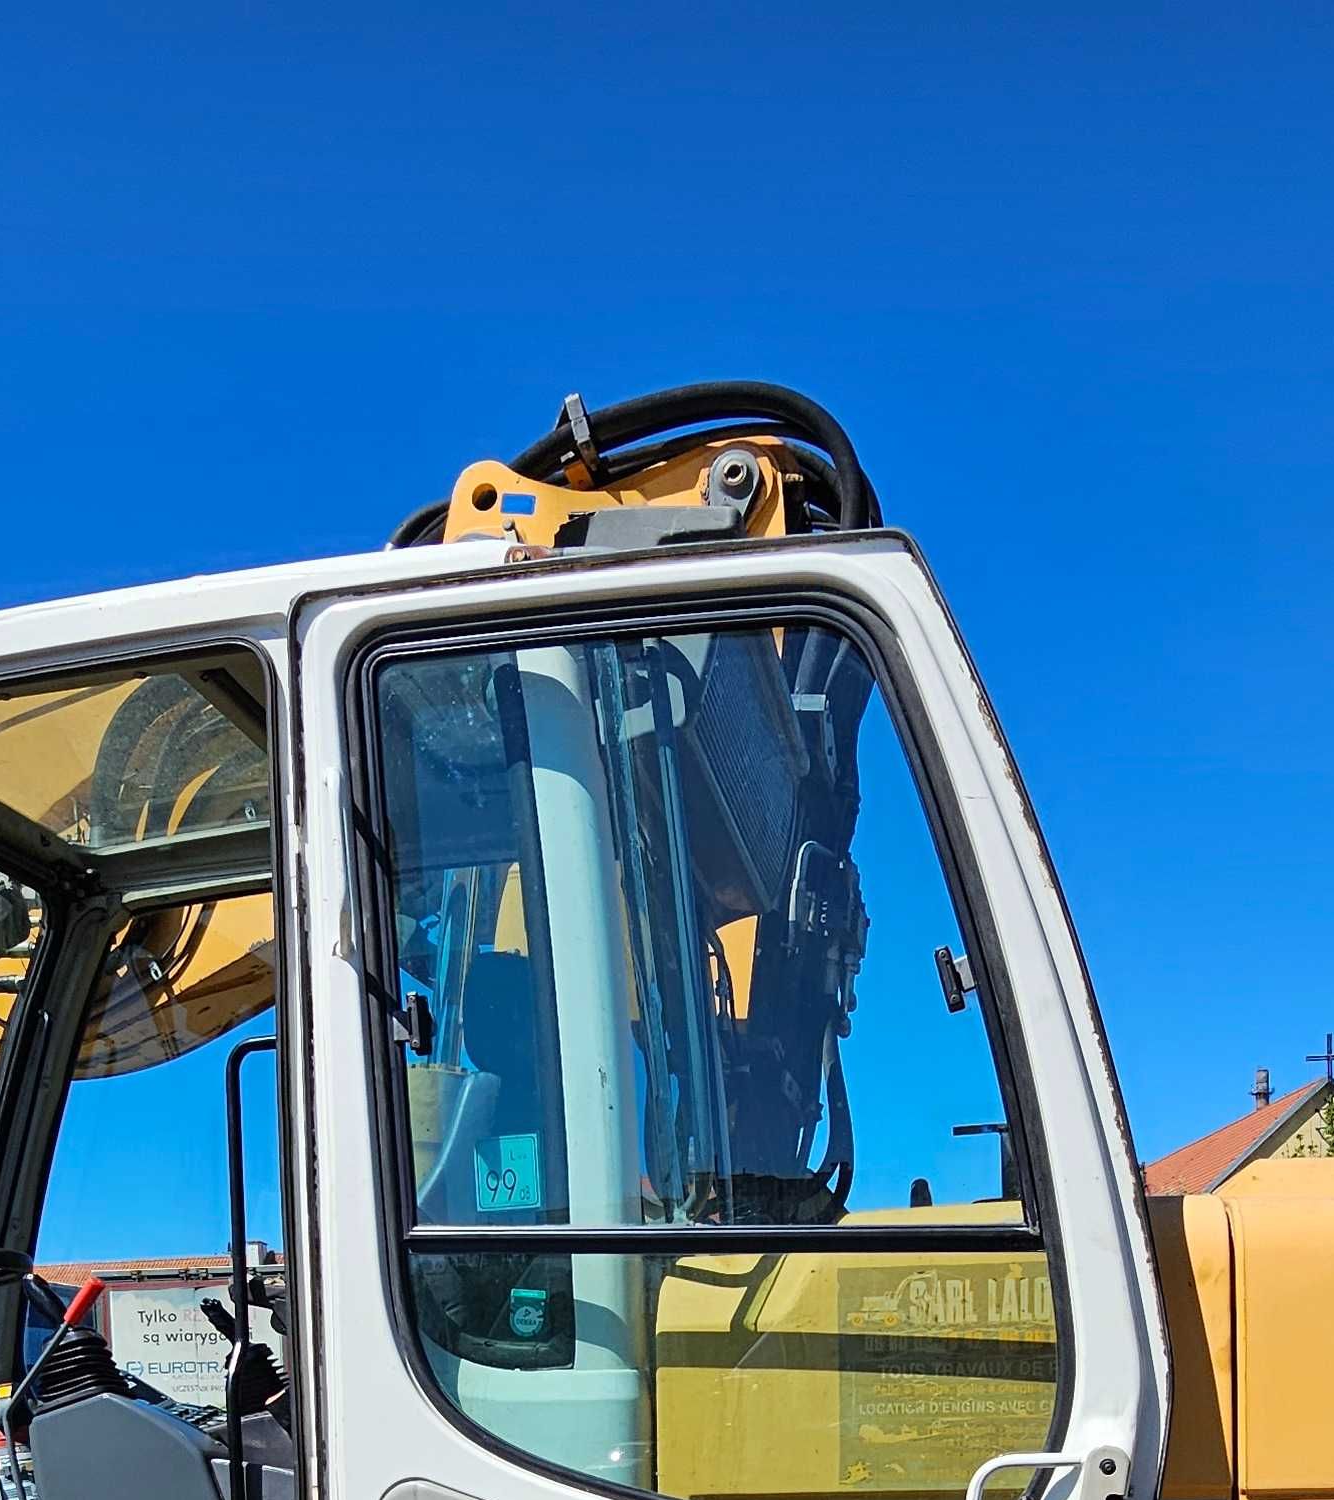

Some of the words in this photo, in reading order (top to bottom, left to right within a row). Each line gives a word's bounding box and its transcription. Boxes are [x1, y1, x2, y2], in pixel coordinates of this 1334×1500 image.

[485, 1168, 517, 1203] 99
[909, 1279, 978, 1324] SARL
[137, 1309, 178, 1326] Tylko
[143, 1333, 160, 1346] są
[166, 1328, 254, 1345] wiarygoi
[148, 1360, 226, 1375] EUROTR
[878, 1362, 926, 1379] TOUS
[932, 1362, 1012, 1378] TRAVAUX
[1019, 1361, 1044, 1377] DE
[859, 1401, 925, 1416] LOCATION
[930, 1400, 995, 1415] D'ENGINS
[998, 1400, 1035, 1414] AVEC
